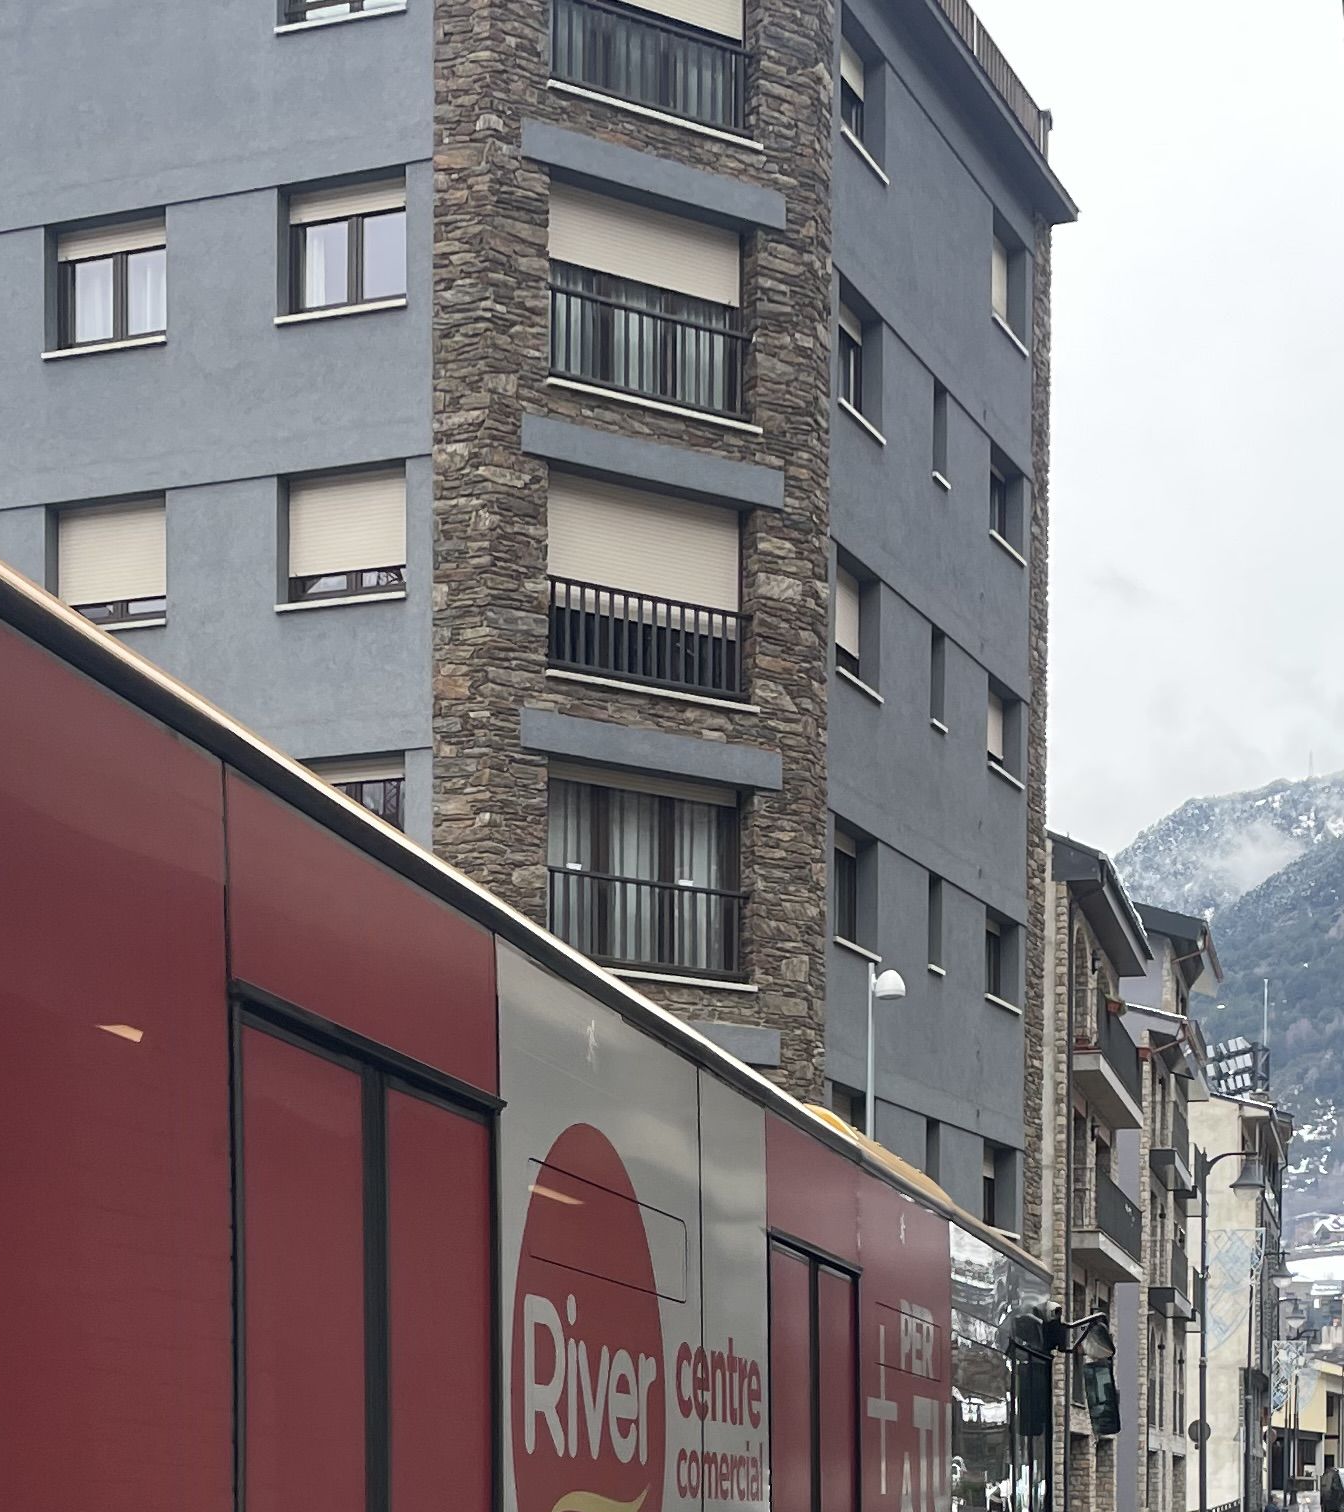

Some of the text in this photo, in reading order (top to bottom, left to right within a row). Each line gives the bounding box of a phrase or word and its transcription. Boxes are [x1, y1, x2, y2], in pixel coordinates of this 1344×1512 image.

[523, 1293, 656, 1466] River
[675, 1336, 762, 1429] centre
[899, 1298, 935, 1380] PER
[676, 1440, 764, 1502] comercial
